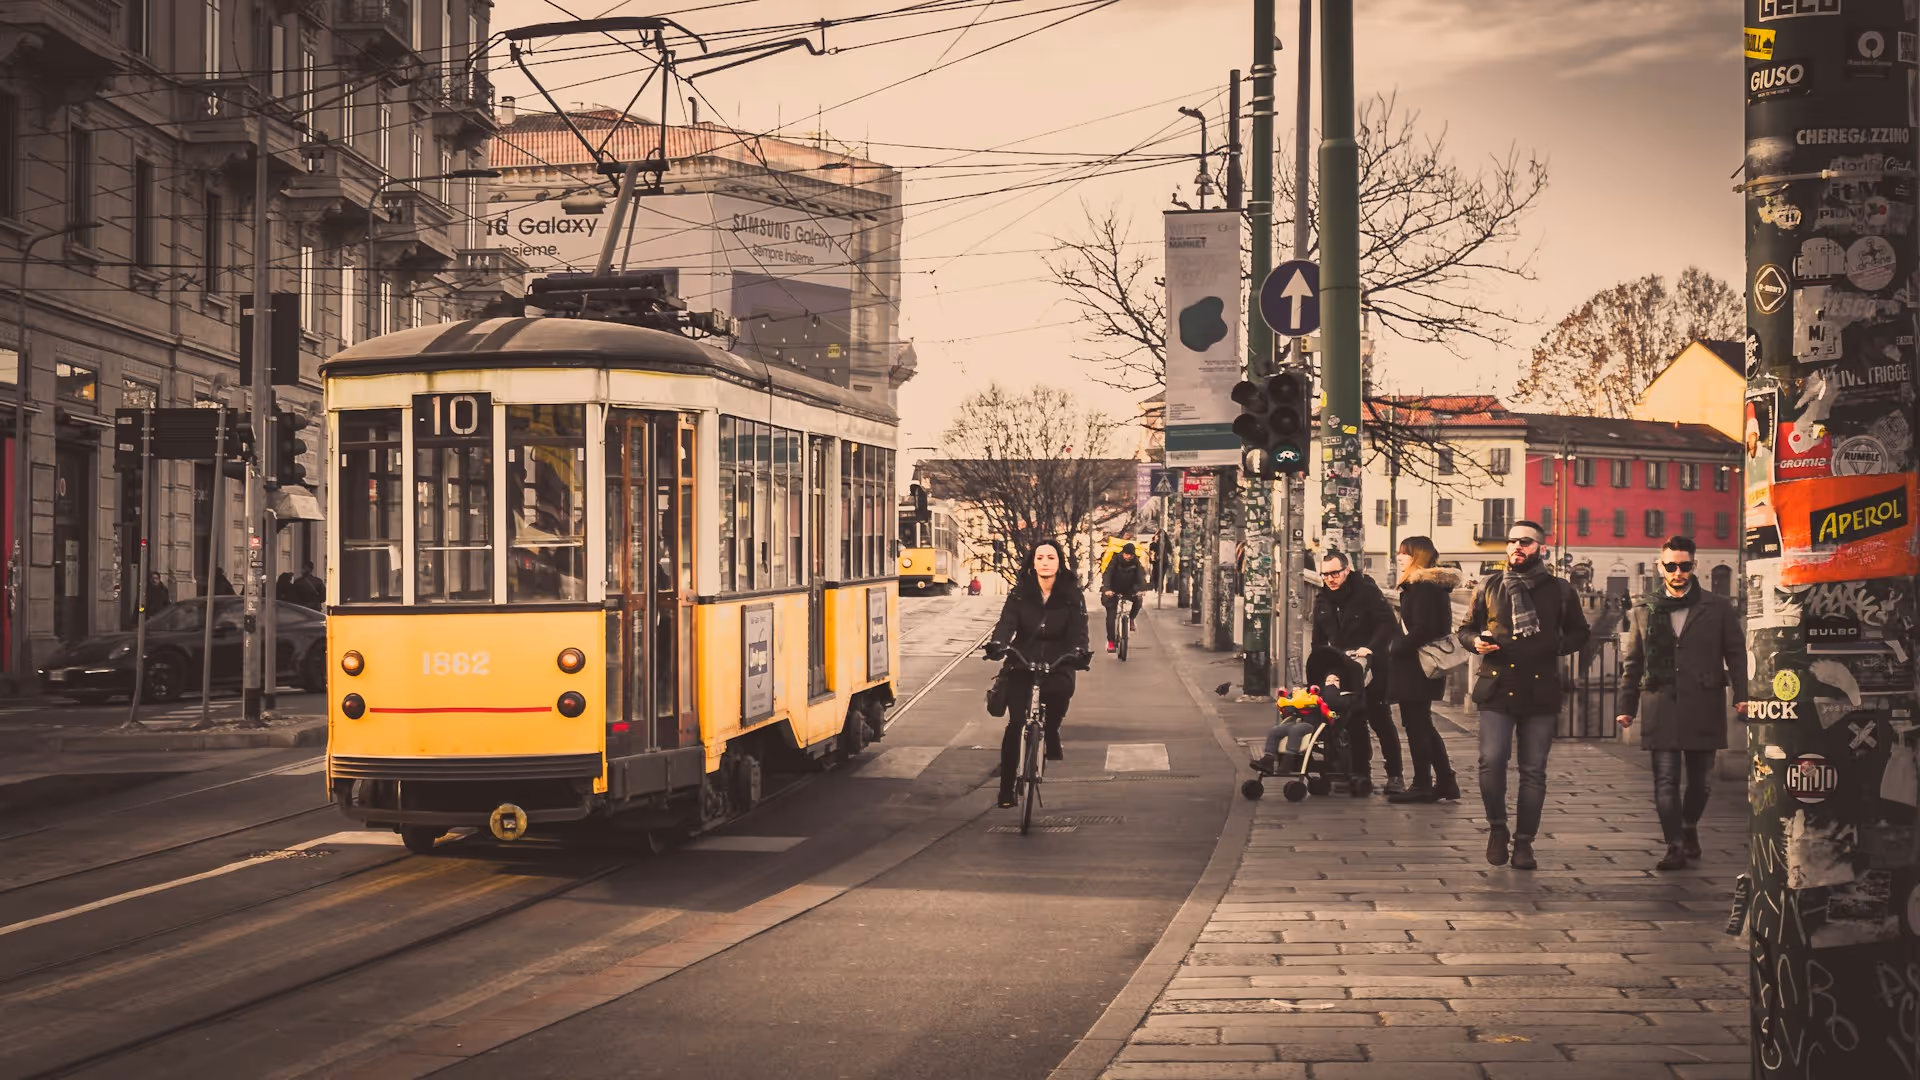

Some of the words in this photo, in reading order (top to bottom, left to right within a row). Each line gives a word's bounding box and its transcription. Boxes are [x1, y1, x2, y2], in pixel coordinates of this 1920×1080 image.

[1751, 64, 1804, 91] GIUSO
[518, 216, 599, 238] Galaxy
[732, 213, 791, 241] SAMSUNG
[794, 226, 834, 254] Galaxy
[432, 395, 479, 436] 10
[1844, 451, 1881, 462] RUMBLE
[1818, 499, 1902, 543] APEROL
[1808, 627, 1858, 637] BULBO
[421, 650, 490, 676] 1862
